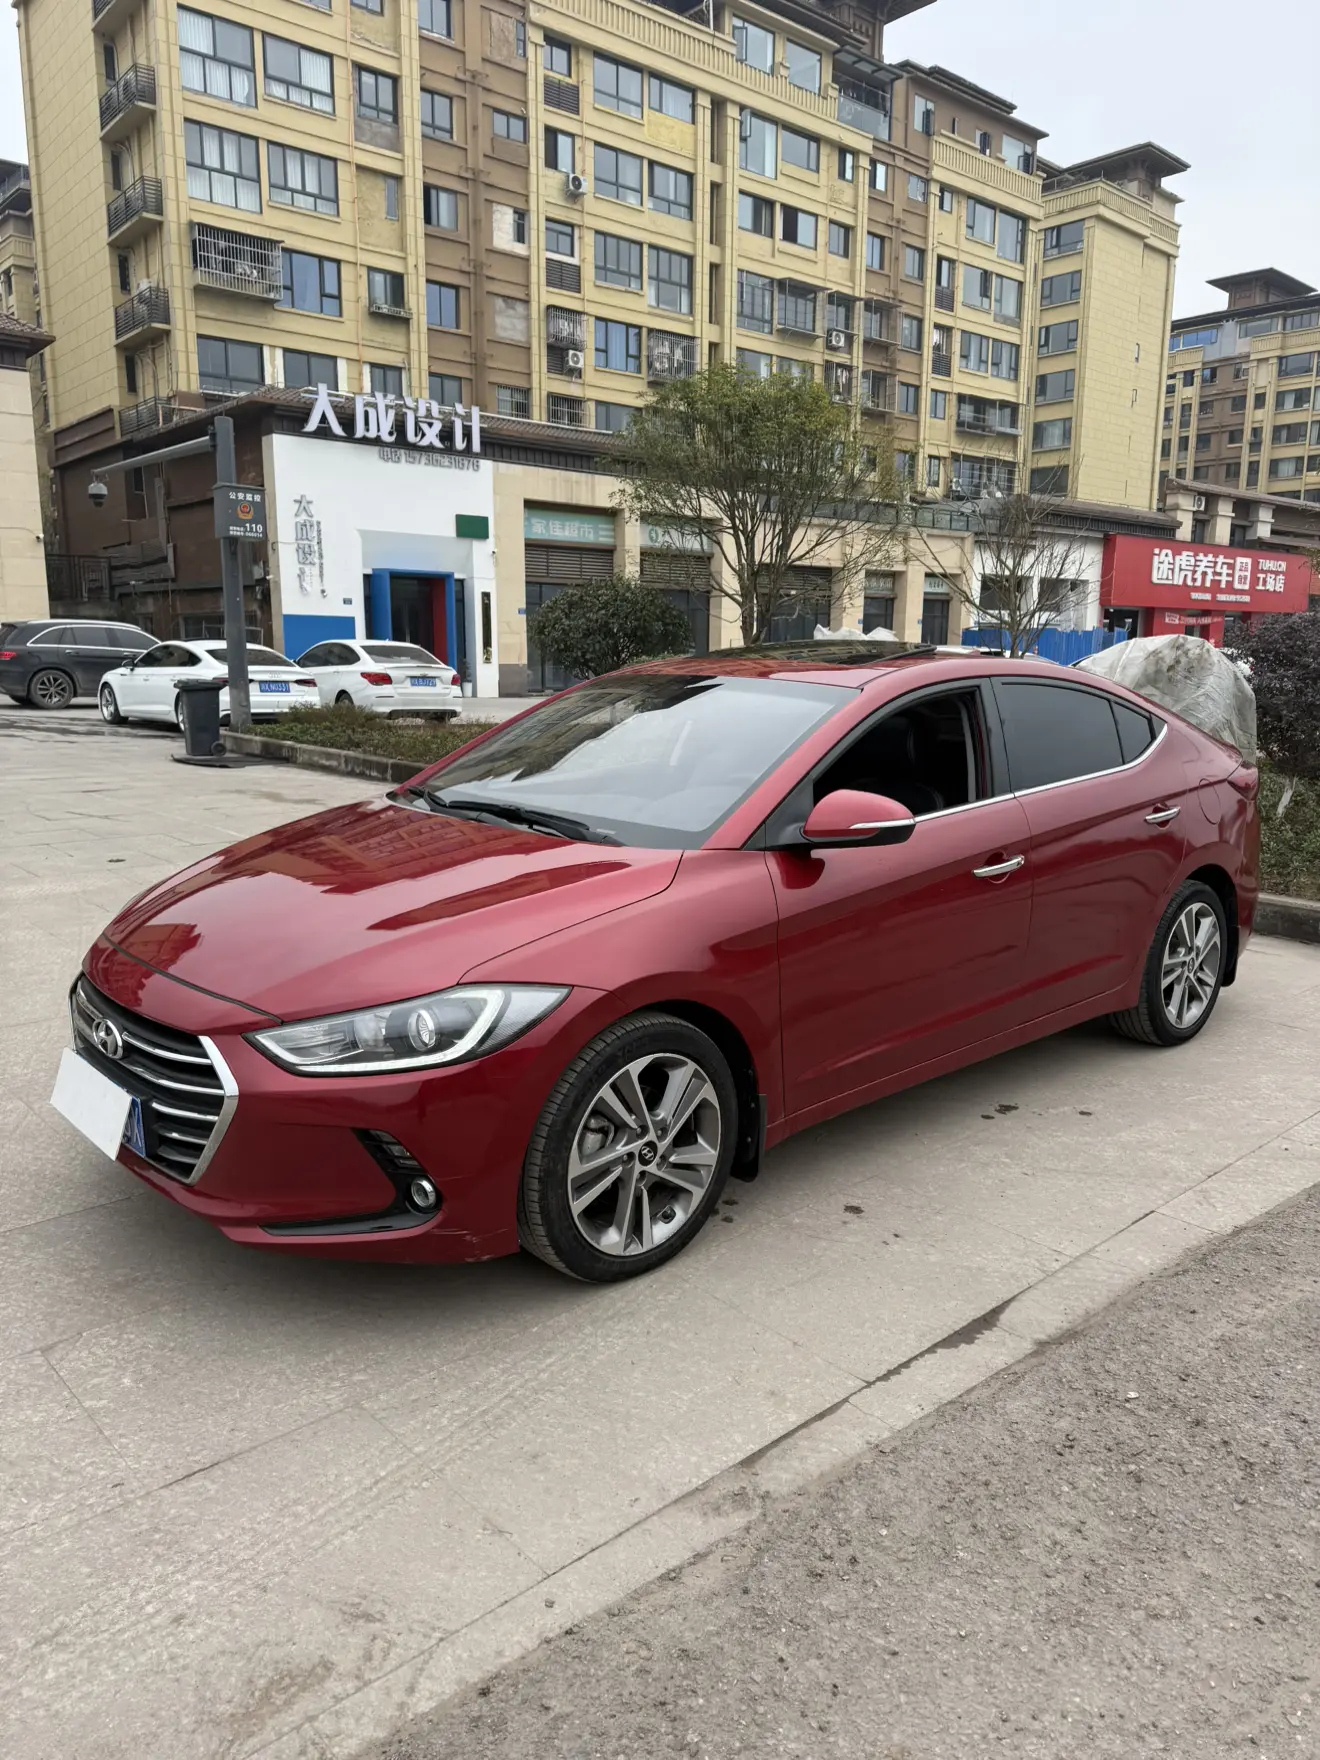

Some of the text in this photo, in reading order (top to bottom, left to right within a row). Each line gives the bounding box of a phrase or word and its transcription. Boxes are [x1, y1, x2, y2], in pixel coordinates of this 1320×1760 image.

[302, 383, 485, 453] 大成设计
[229, 491, 261, 502] 公安监控
[245, 523, 263, 533] 110
[1152, 547, 1235, 589] 途虎养车
[1255, 573, 1285, 592] 工场店
